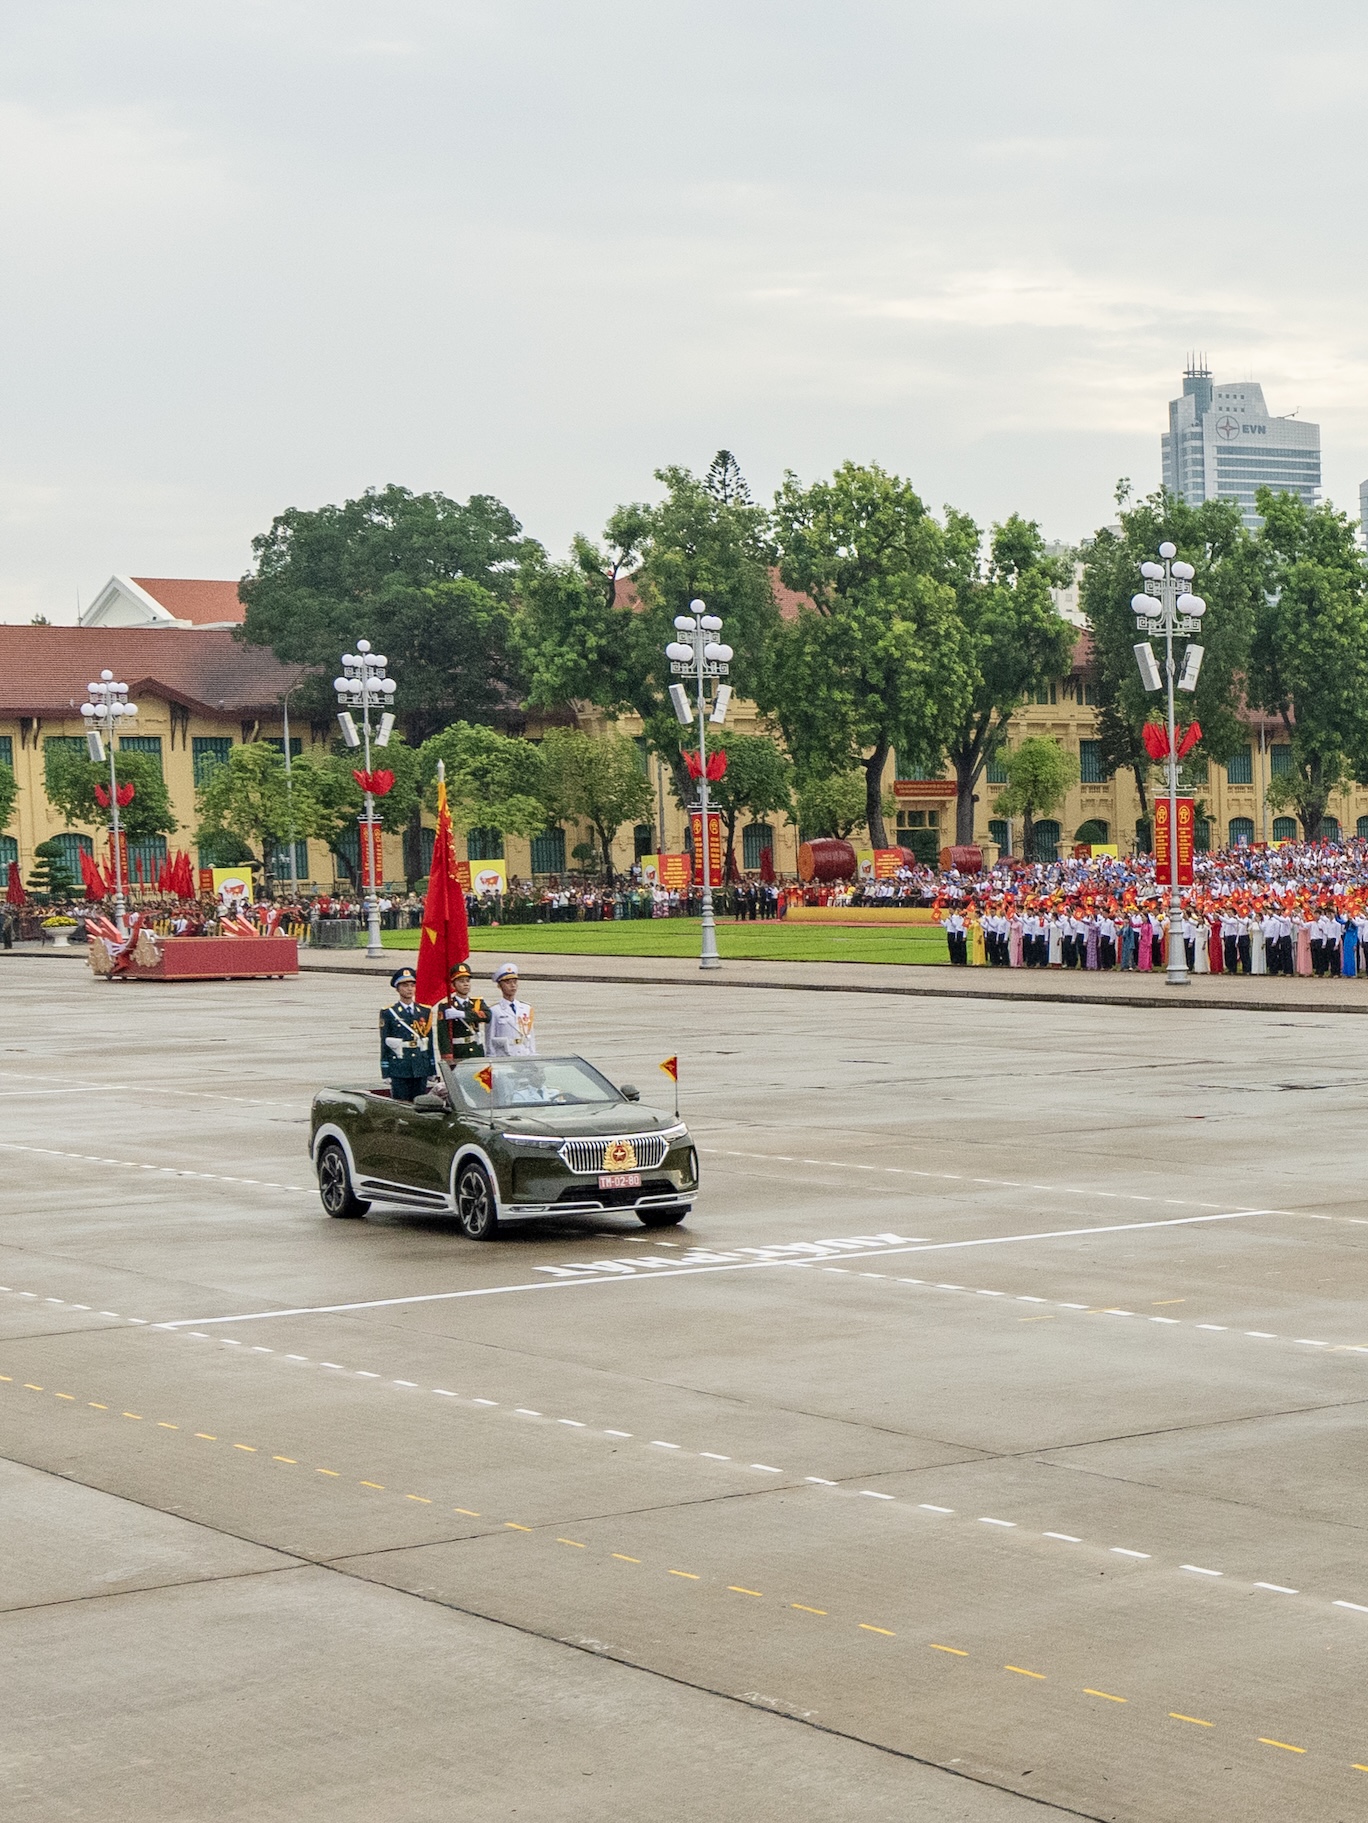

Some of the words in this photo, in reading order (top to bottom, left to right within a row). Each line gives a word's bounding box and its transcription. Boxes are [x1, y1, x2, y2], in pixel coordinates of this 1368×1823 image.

[1242, 424, 1266, 434] EVN
[601, 1176, 640, 1187] TM-02-80
[734, 1233, 931, 1257] XUẤT
[532, 1252, 742, 1277] PHÁT
